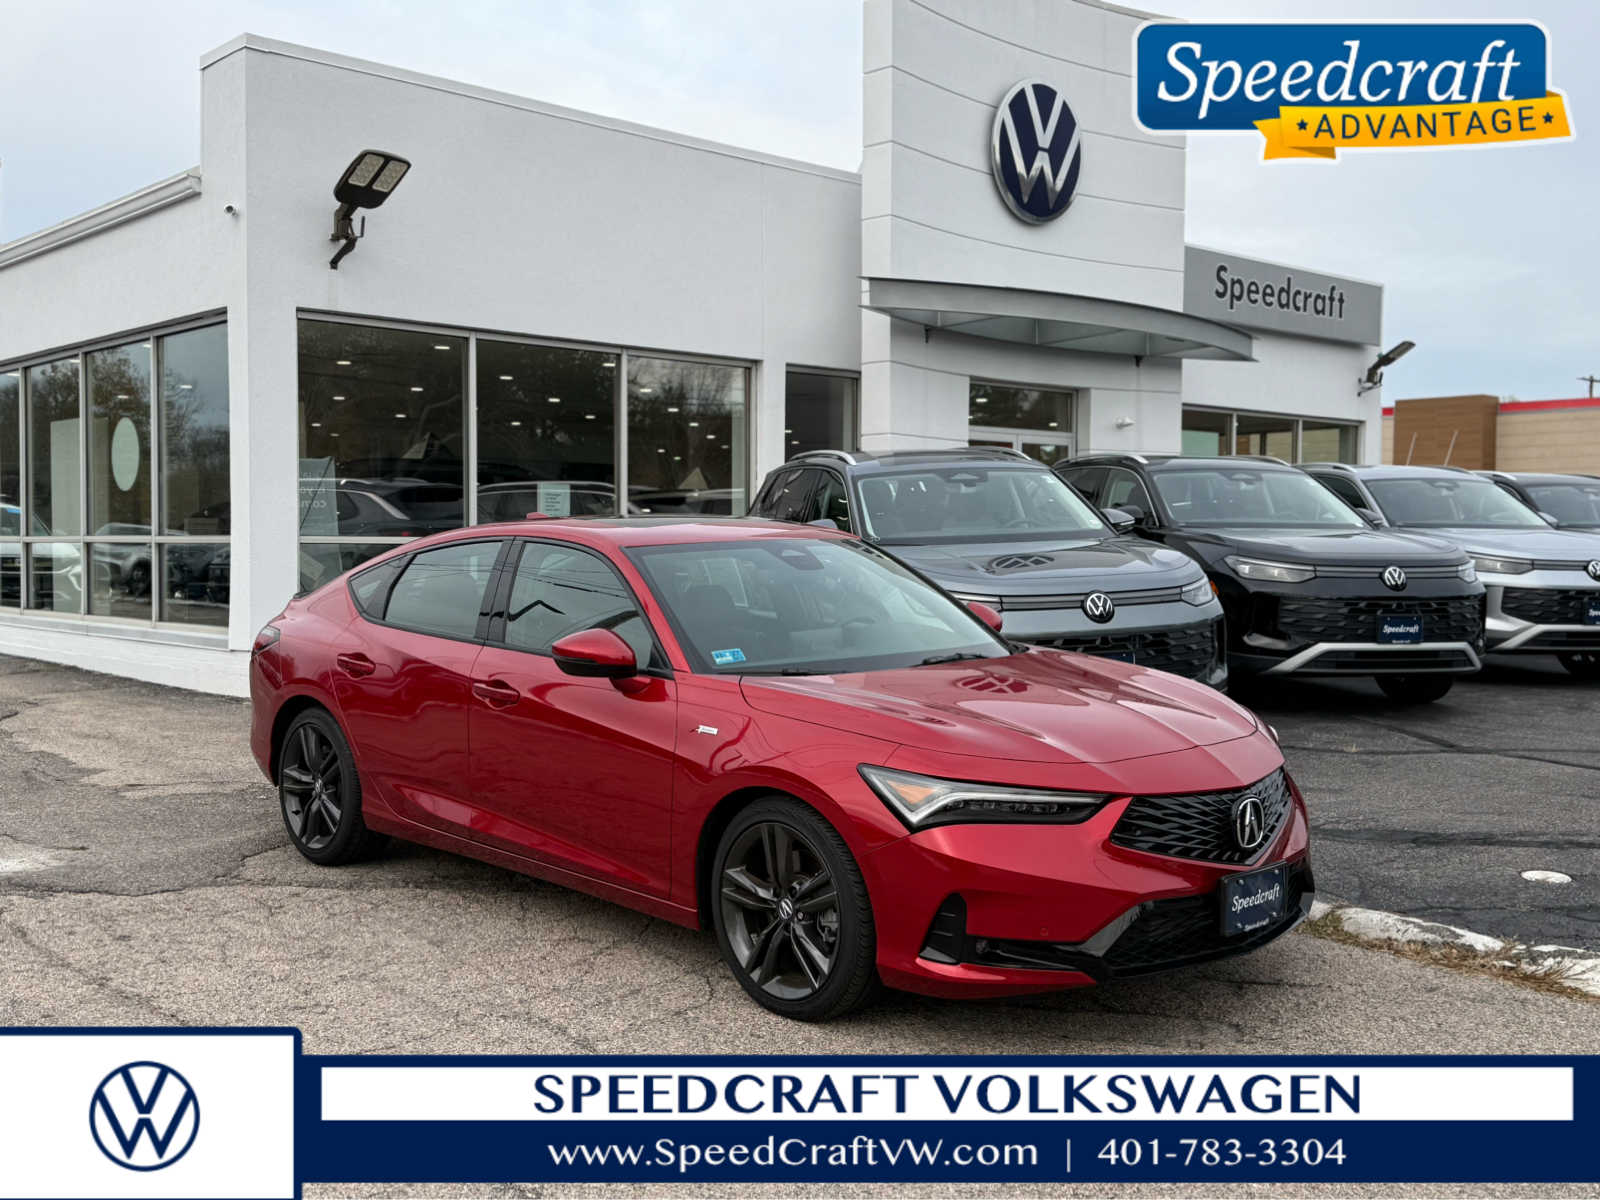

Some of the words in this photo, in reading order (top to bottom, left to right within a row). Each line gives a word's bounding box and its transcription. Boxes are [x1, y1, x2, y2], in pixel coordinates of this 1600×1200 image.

[1215, 265, 1345, 318] Speedcraft
[1383, 624, 1419, 634] Speedcraft
[1231, 883, 1280, 913] Speedcraft
